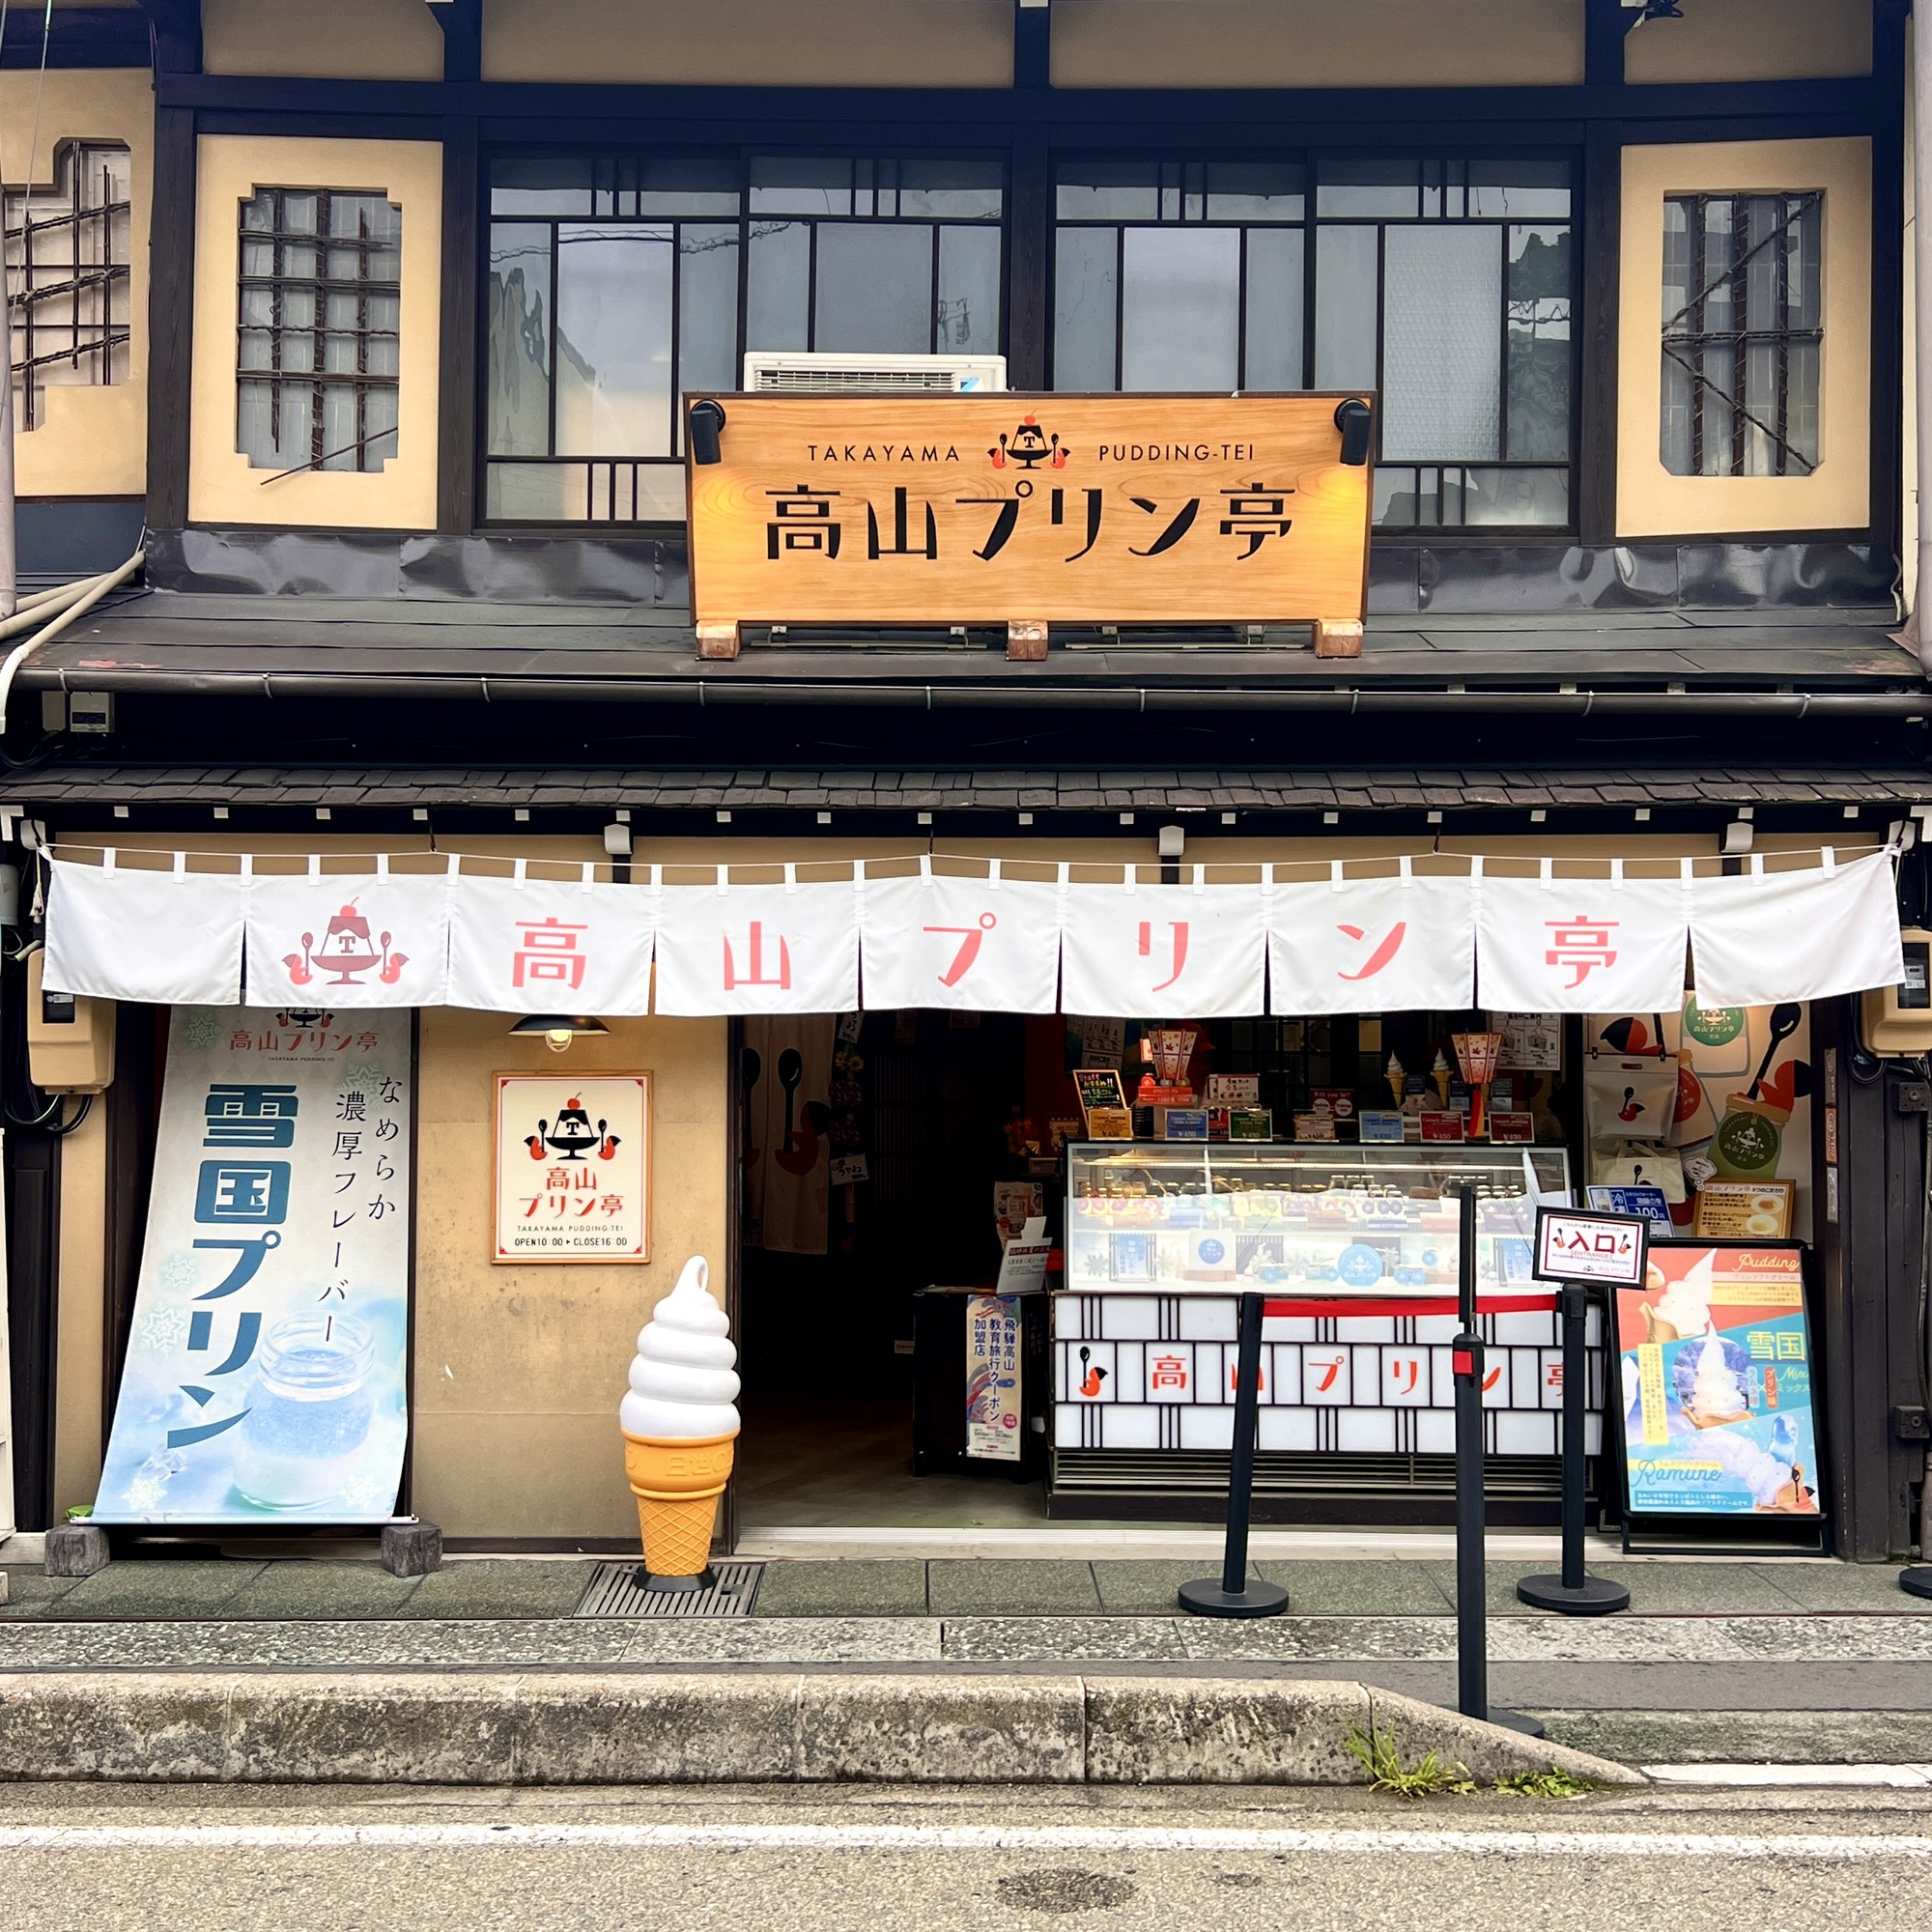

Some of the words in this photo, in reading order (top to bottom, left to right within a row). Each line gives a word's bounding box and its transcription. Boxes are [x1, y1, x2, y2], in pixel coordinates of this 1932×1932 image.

[808, 444, 960, 462] TAKAYAMA
[1098, 443, 1255, 462] PUDDING-TEI
[765, 480, 1295, 563] 高山プリン亭
[511, 912, 1620, 990] 高山プリン亭
[230, 1029, 380, 1054] 高山プリン亭
[366, 1076, 403, 1221] なめらか
[546, 1166, 597, 1190] 高山
[314, 1091, 366, 1343] 濃厚フレーバー
[519, 1193, 624, 1218] プリン亭
[1568, 1231, 1615, 1254] 入口
[166, 1083, 299, 1450] 雪国プリン
[1732, 1253, 1801, 1272] Pudding
[974, 1319, 987, 1357] 加盟店
[1747, 1330, 1805, 1361] 雪国
[988, 1319, 1002, 1422] 教育旅行クーポン
[1631, 1460, 1722, 1488] Ramune
